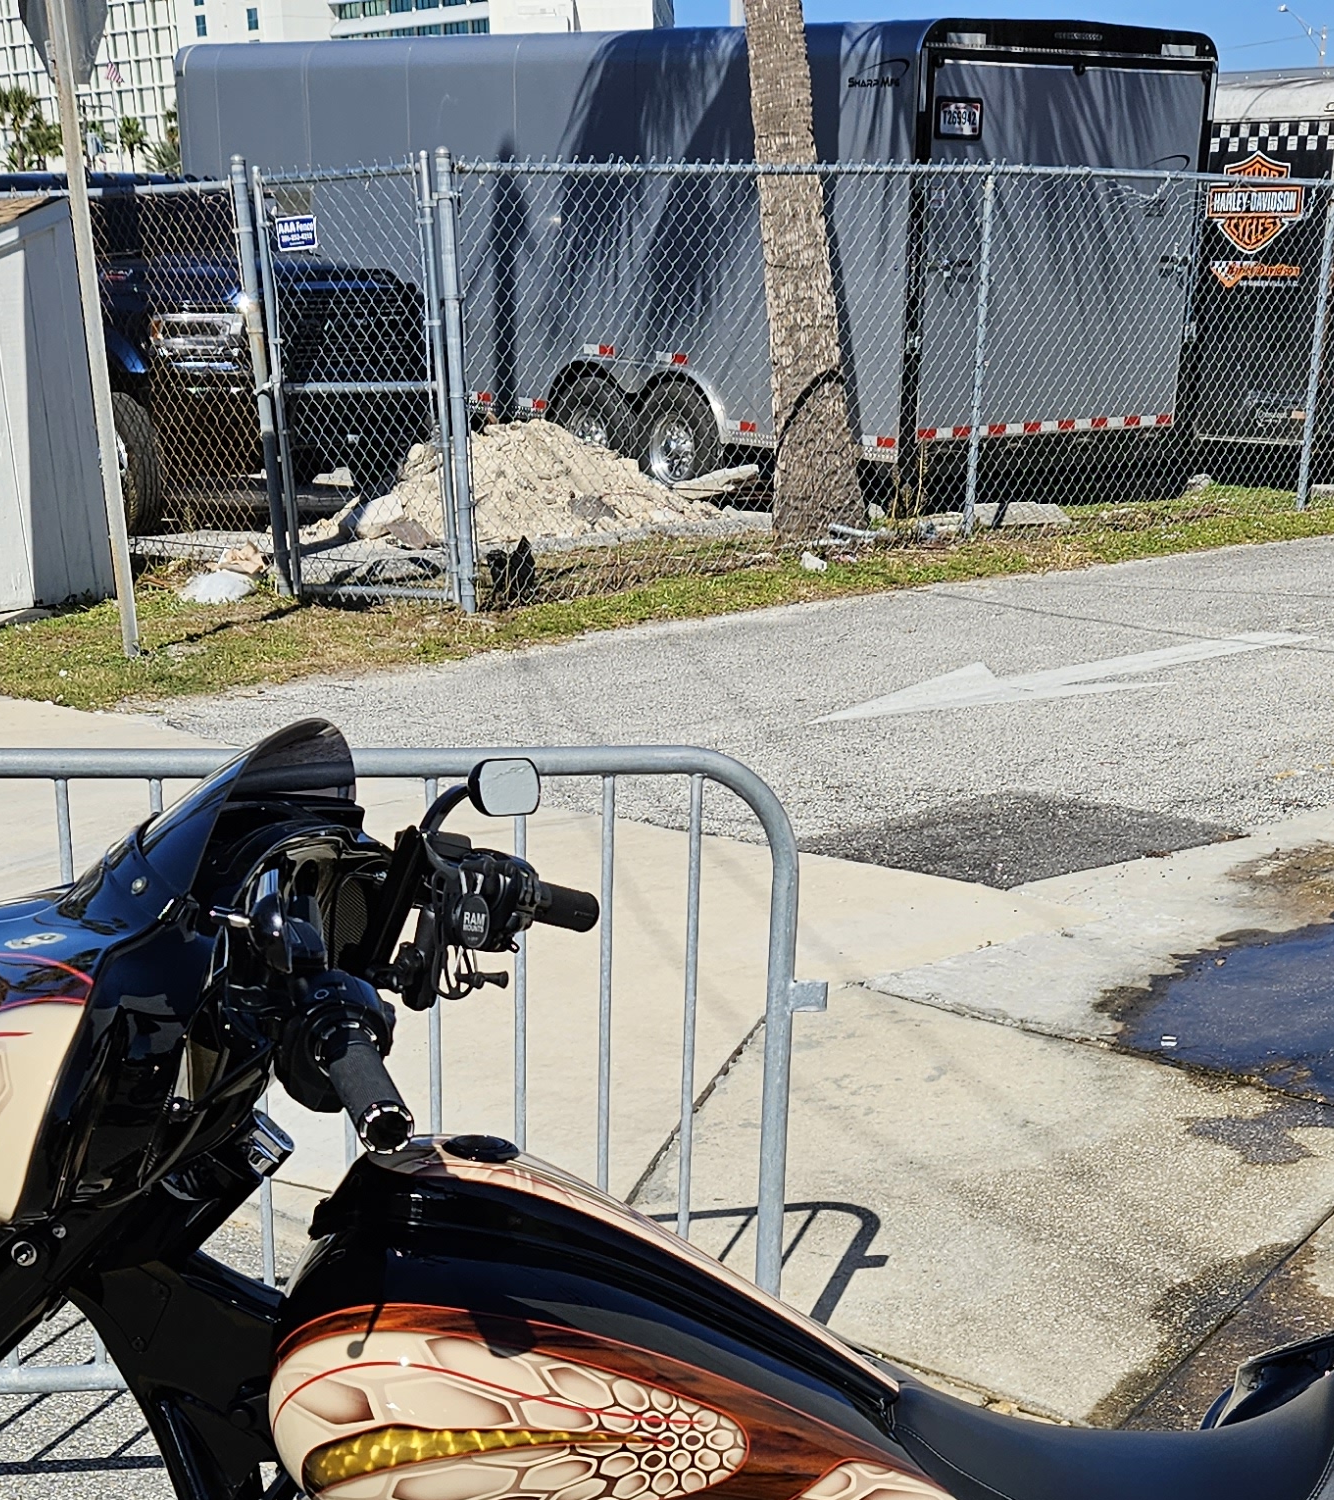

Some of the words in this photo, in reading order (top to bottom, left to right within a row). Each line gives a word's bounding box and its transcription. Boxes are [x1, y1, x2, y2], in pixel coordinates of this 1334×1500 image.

[1213, 190, 1297, 213] HARLEY-DAVIDSON
[278, 221, 296, 234] AAA
[463, 911, 486, 926] RAM
